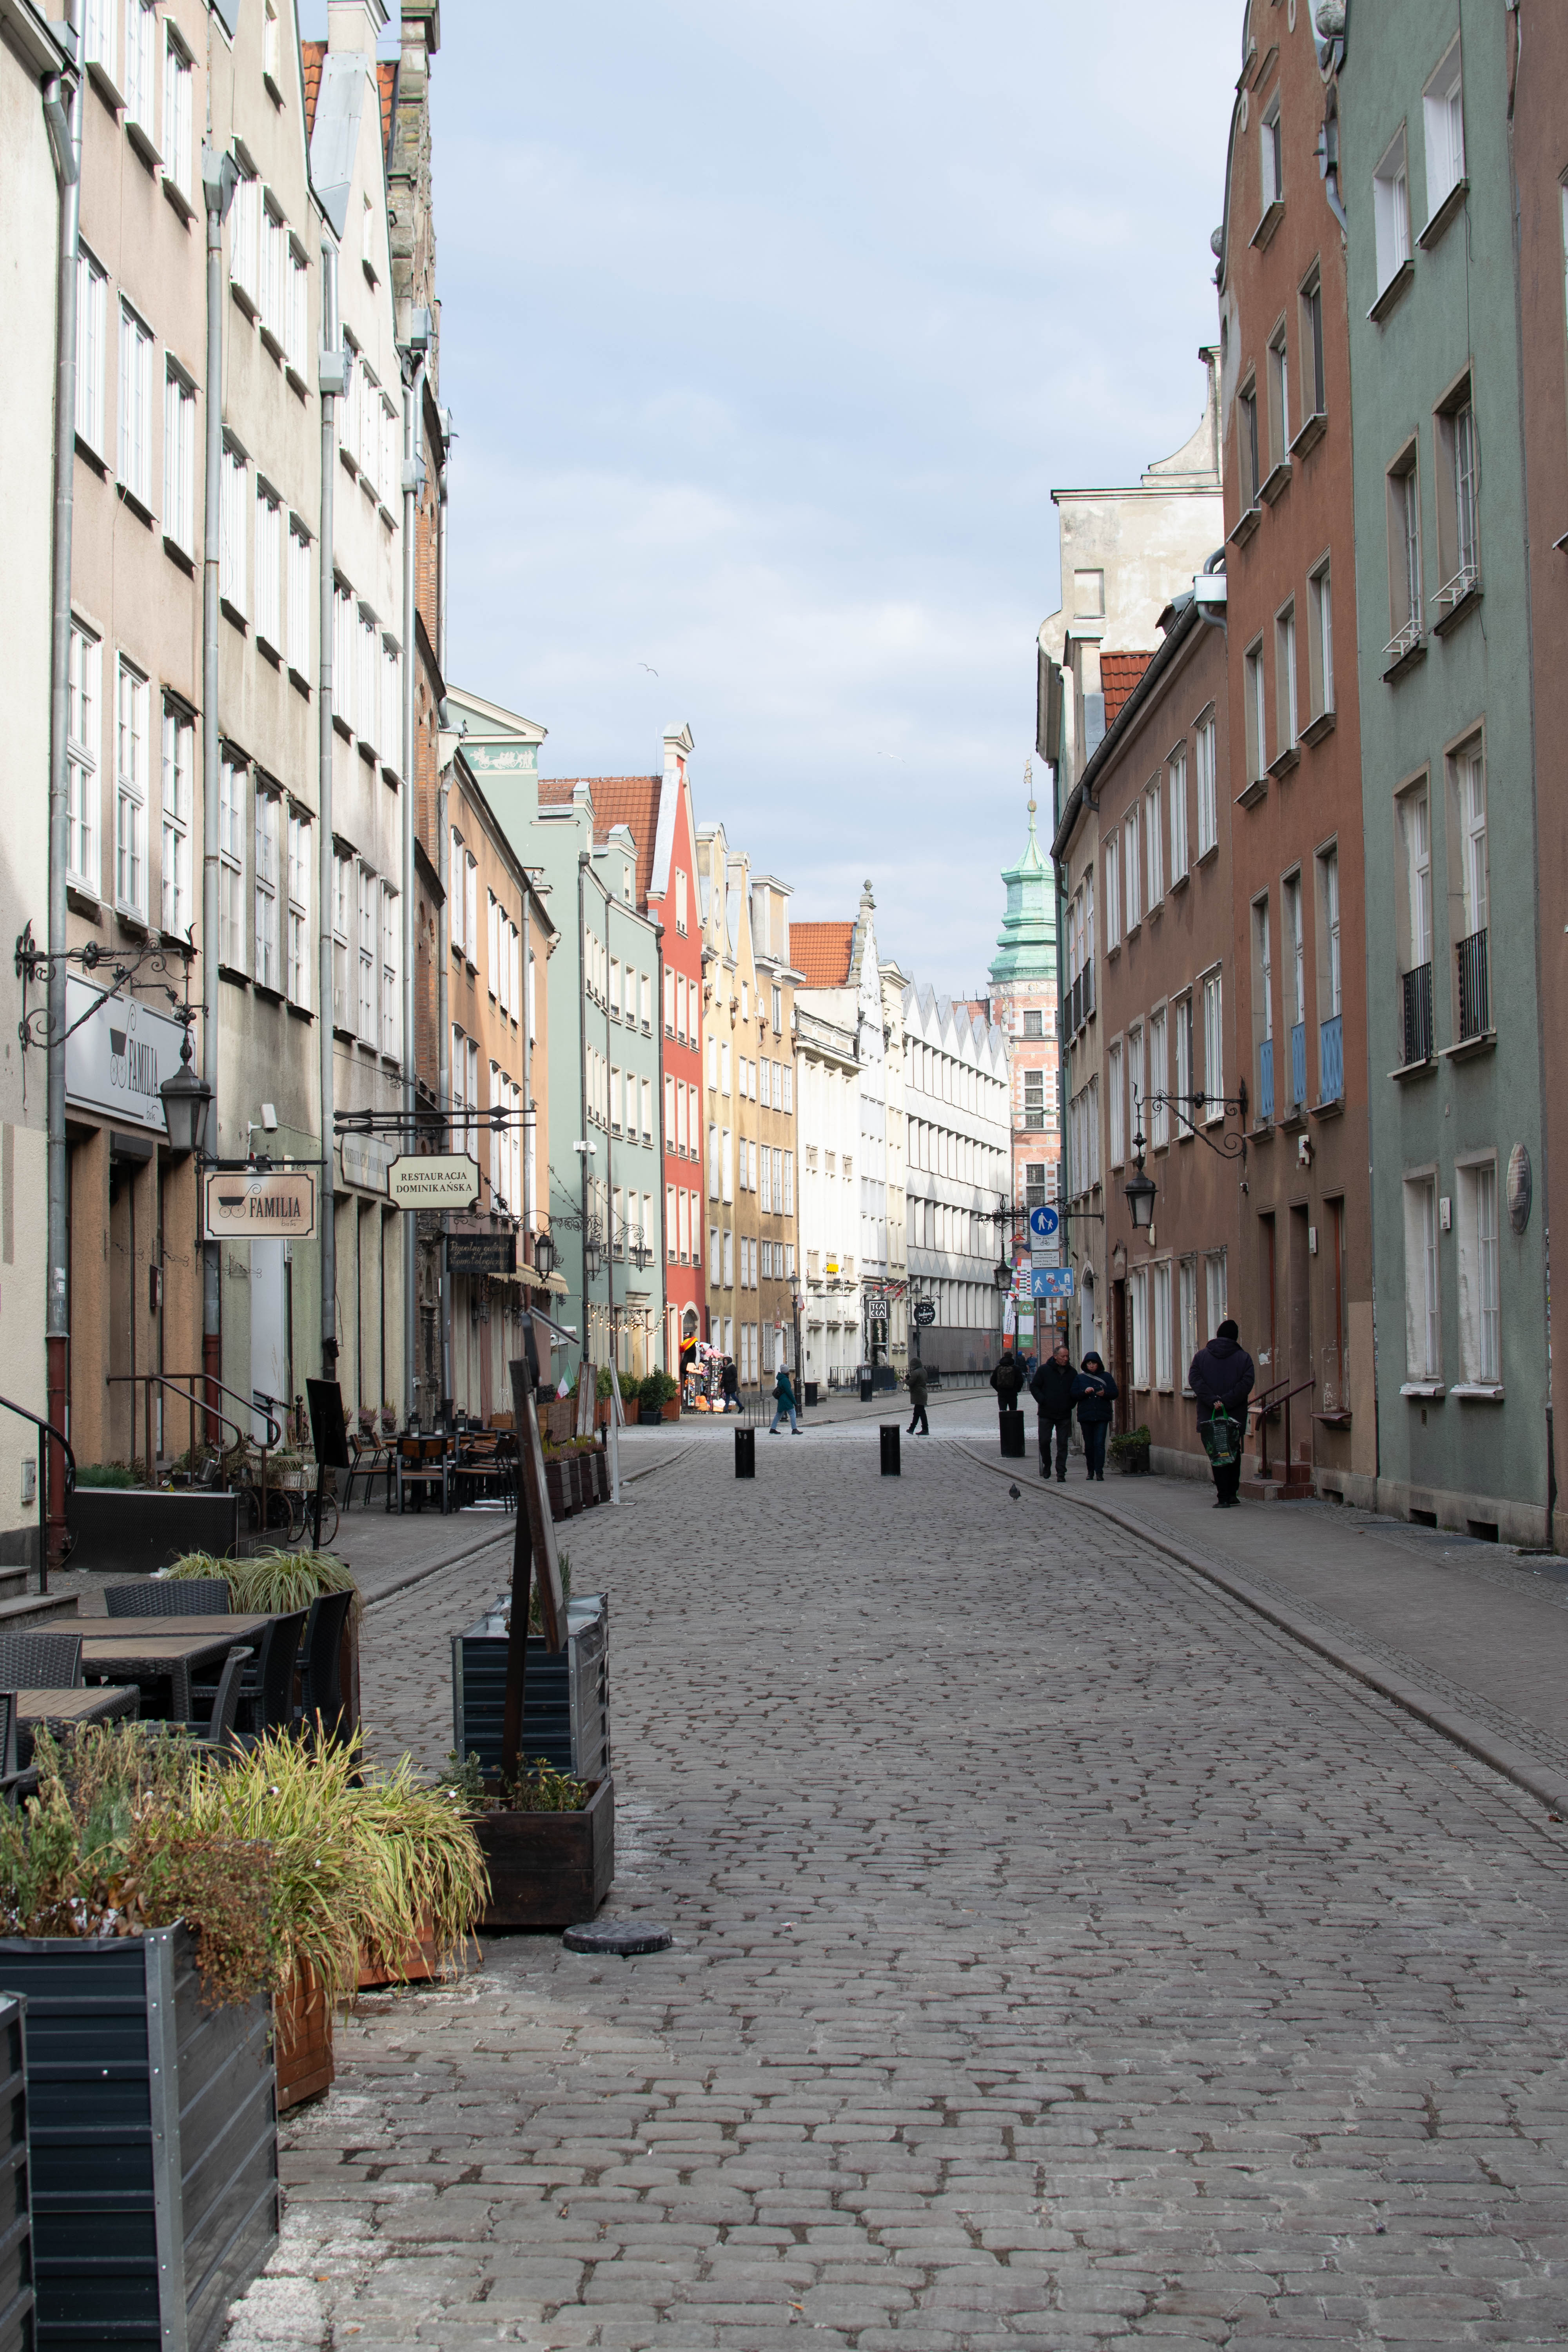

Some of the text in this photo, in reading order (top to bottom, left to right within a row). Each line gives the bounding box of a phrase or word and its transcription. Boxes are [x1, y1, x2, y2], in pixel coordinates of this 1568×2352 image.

[129, 1039, 158, 1099] FAMILIA
[401, 1172, 467, 1181] RESTAURACJA
[396, 1181, 472, 1192] DOMINIKAŃSKA
[249, 1197, 301, 1217] FAMILIA
[1441, 1201, 1446, 1219] 12
